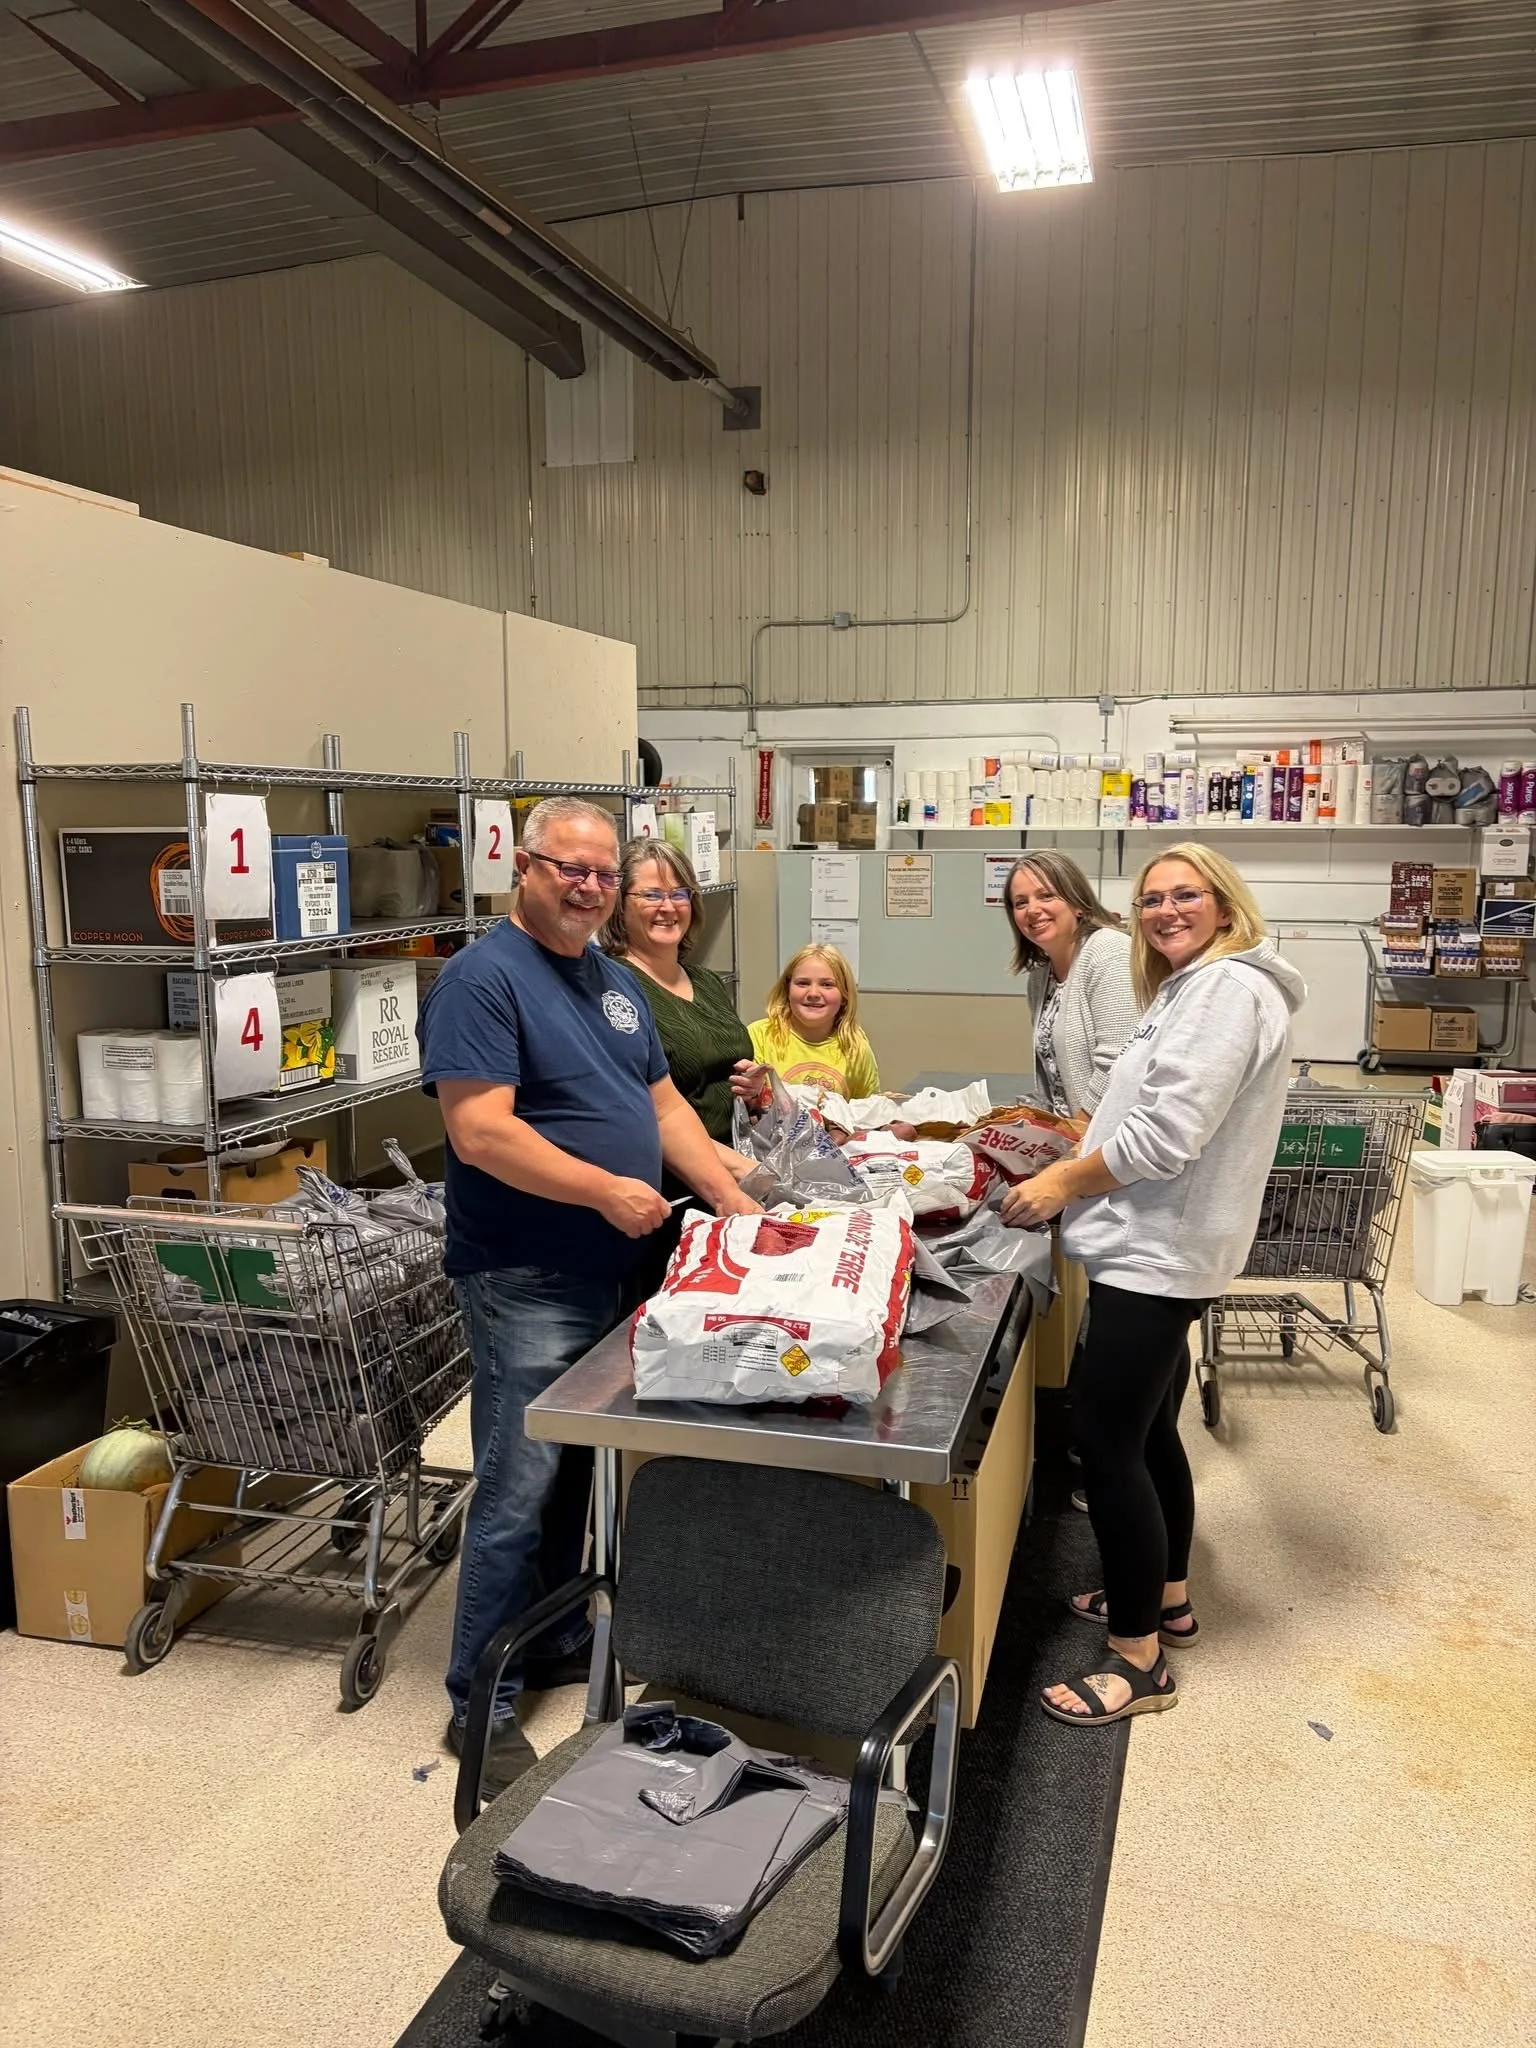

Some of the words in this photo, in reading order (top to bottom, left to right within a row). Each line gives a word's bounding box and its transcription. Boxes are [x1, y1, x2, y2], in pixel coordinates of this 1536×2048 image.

[1504, 782, 1515, 804] Purex
[1525, 781, 1535, 804] Purex
[230, 827, 250, 874] 1
[487, 824, 502, 860] 2
[307, 907, 332, 917] 732124
[73, 931, 110, 942] COPPER
[113, 932, 143, 942] MOON
[219, 929, 249, 941] COPPER
[249, 928, 272, 938] MOON
[379, 995, 401, 1024] RR
[241, 1007, 264, 1052] 4
[372, 1023, 409, 1049] ROYAL
[373, 1042, 410, 1065] RESERVE
[831, 1248, 868, 1295] TERRE
